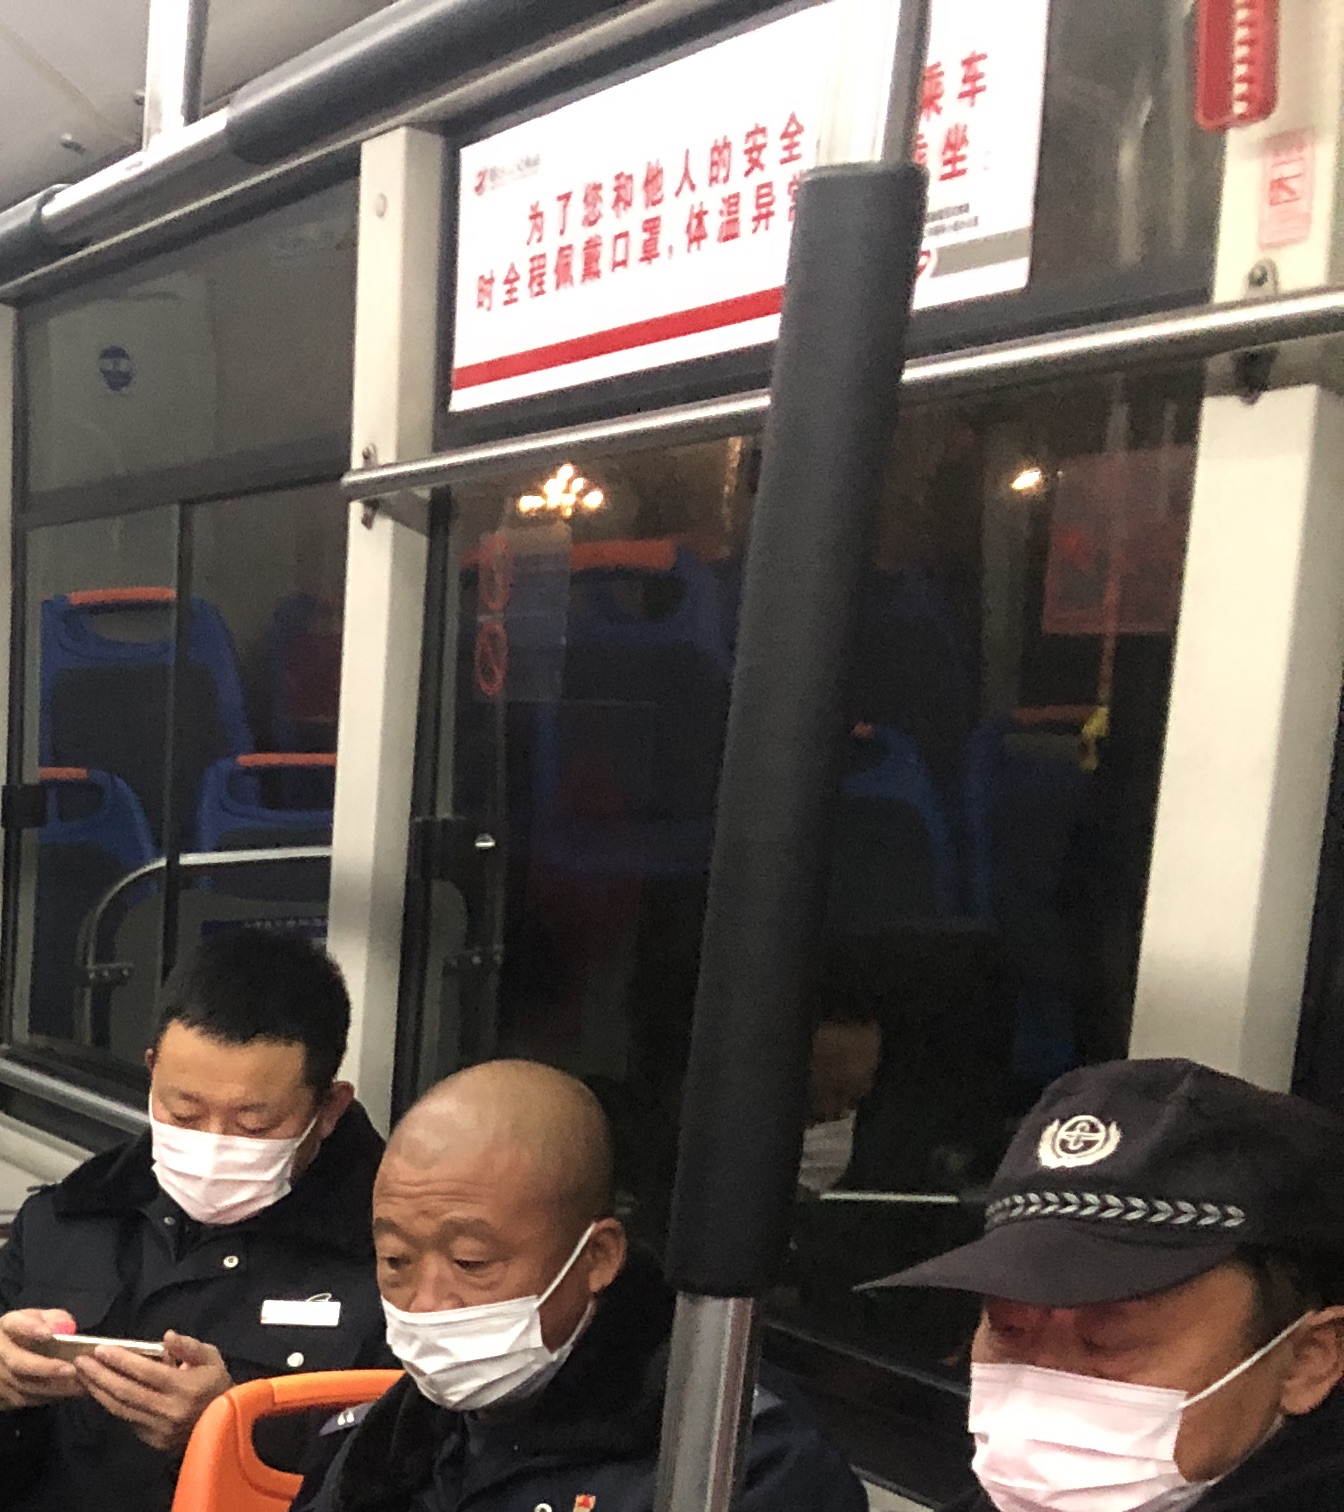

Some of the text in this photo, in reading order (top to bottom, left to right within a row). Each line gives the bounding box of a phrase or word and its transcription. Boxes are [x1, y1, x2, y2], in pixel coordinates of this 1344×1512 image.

[526, 110, 805, 246] 为了您和他人的安全
